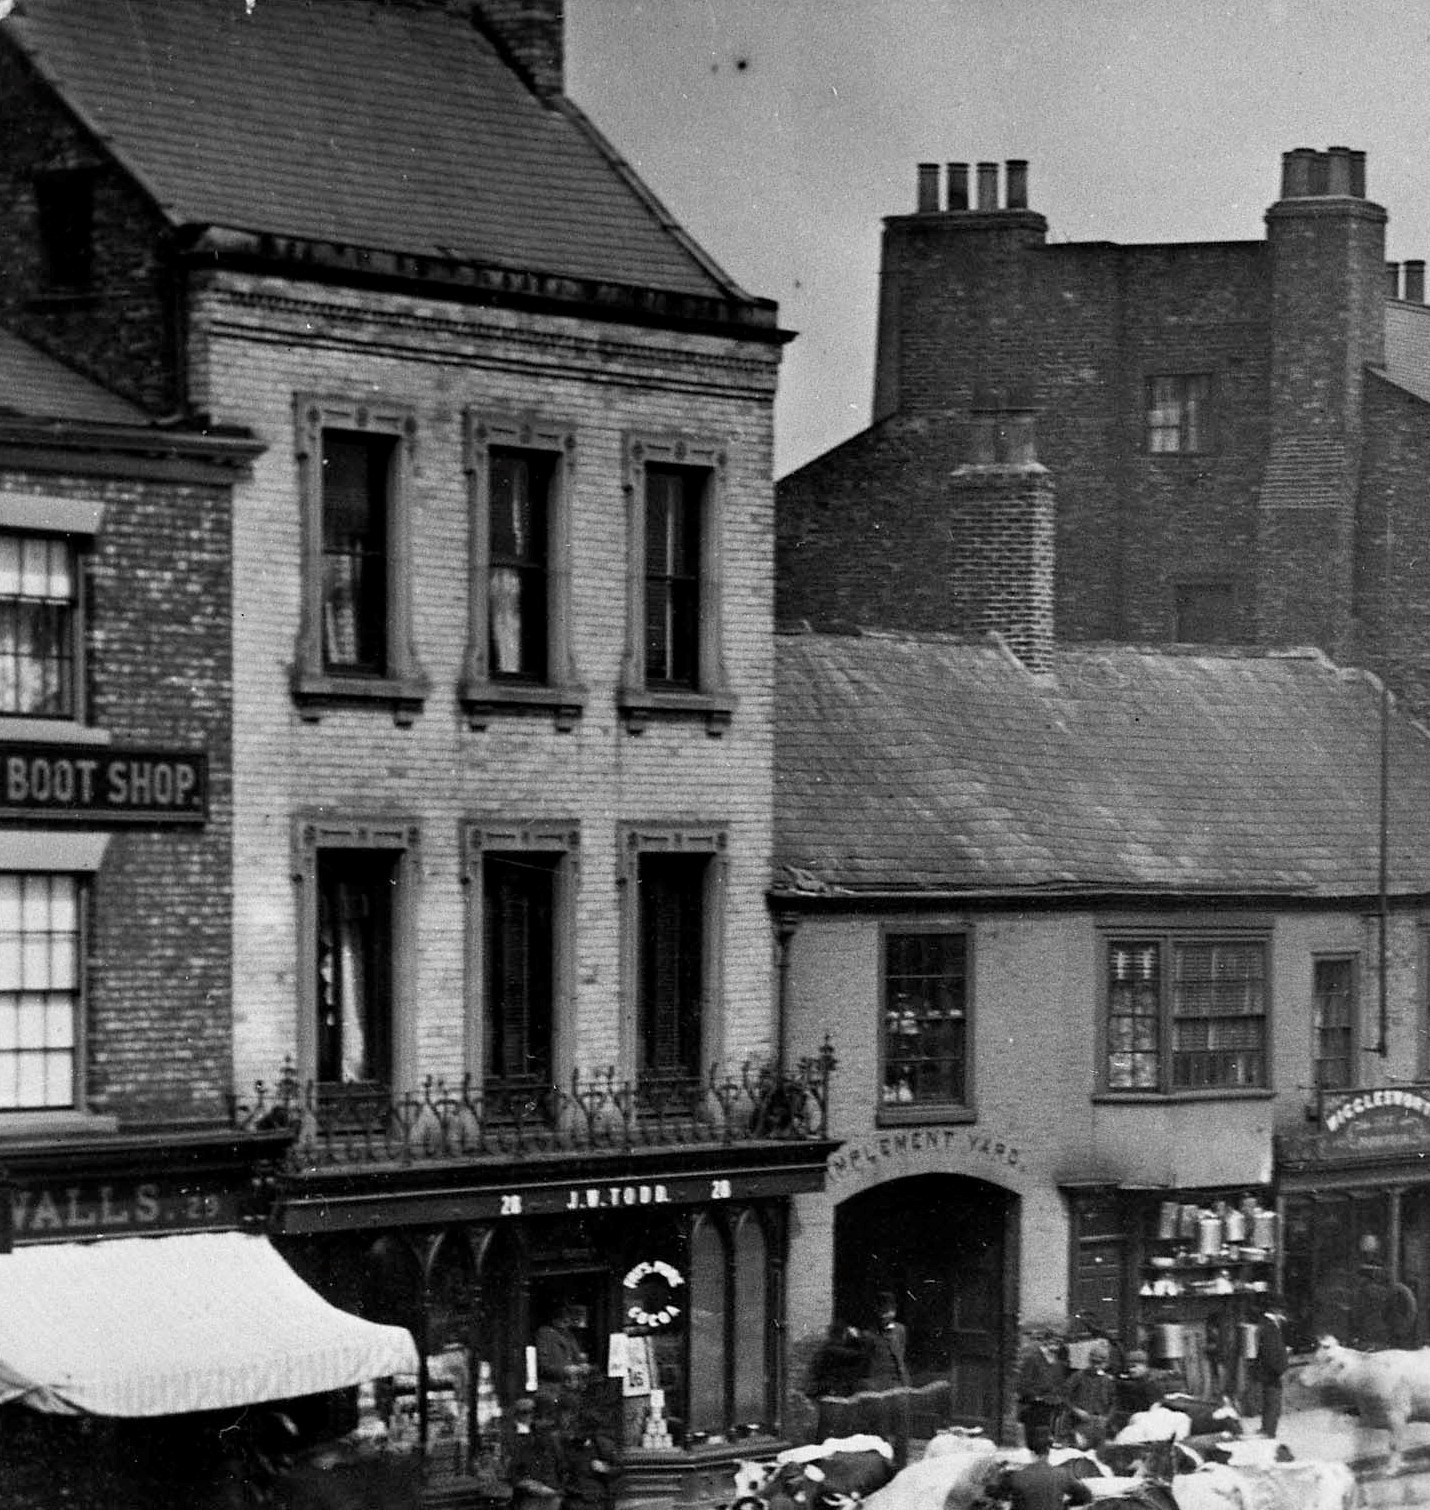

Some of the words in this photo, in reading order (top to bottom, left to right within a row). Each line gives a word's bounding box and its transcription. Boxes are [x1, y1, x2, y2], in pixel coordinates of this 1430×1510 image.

[7, 757, 100, 803] BOOT
[108, 761, 202, 805] SHOP.
[628, 1306, 681, 1327] COCOA
